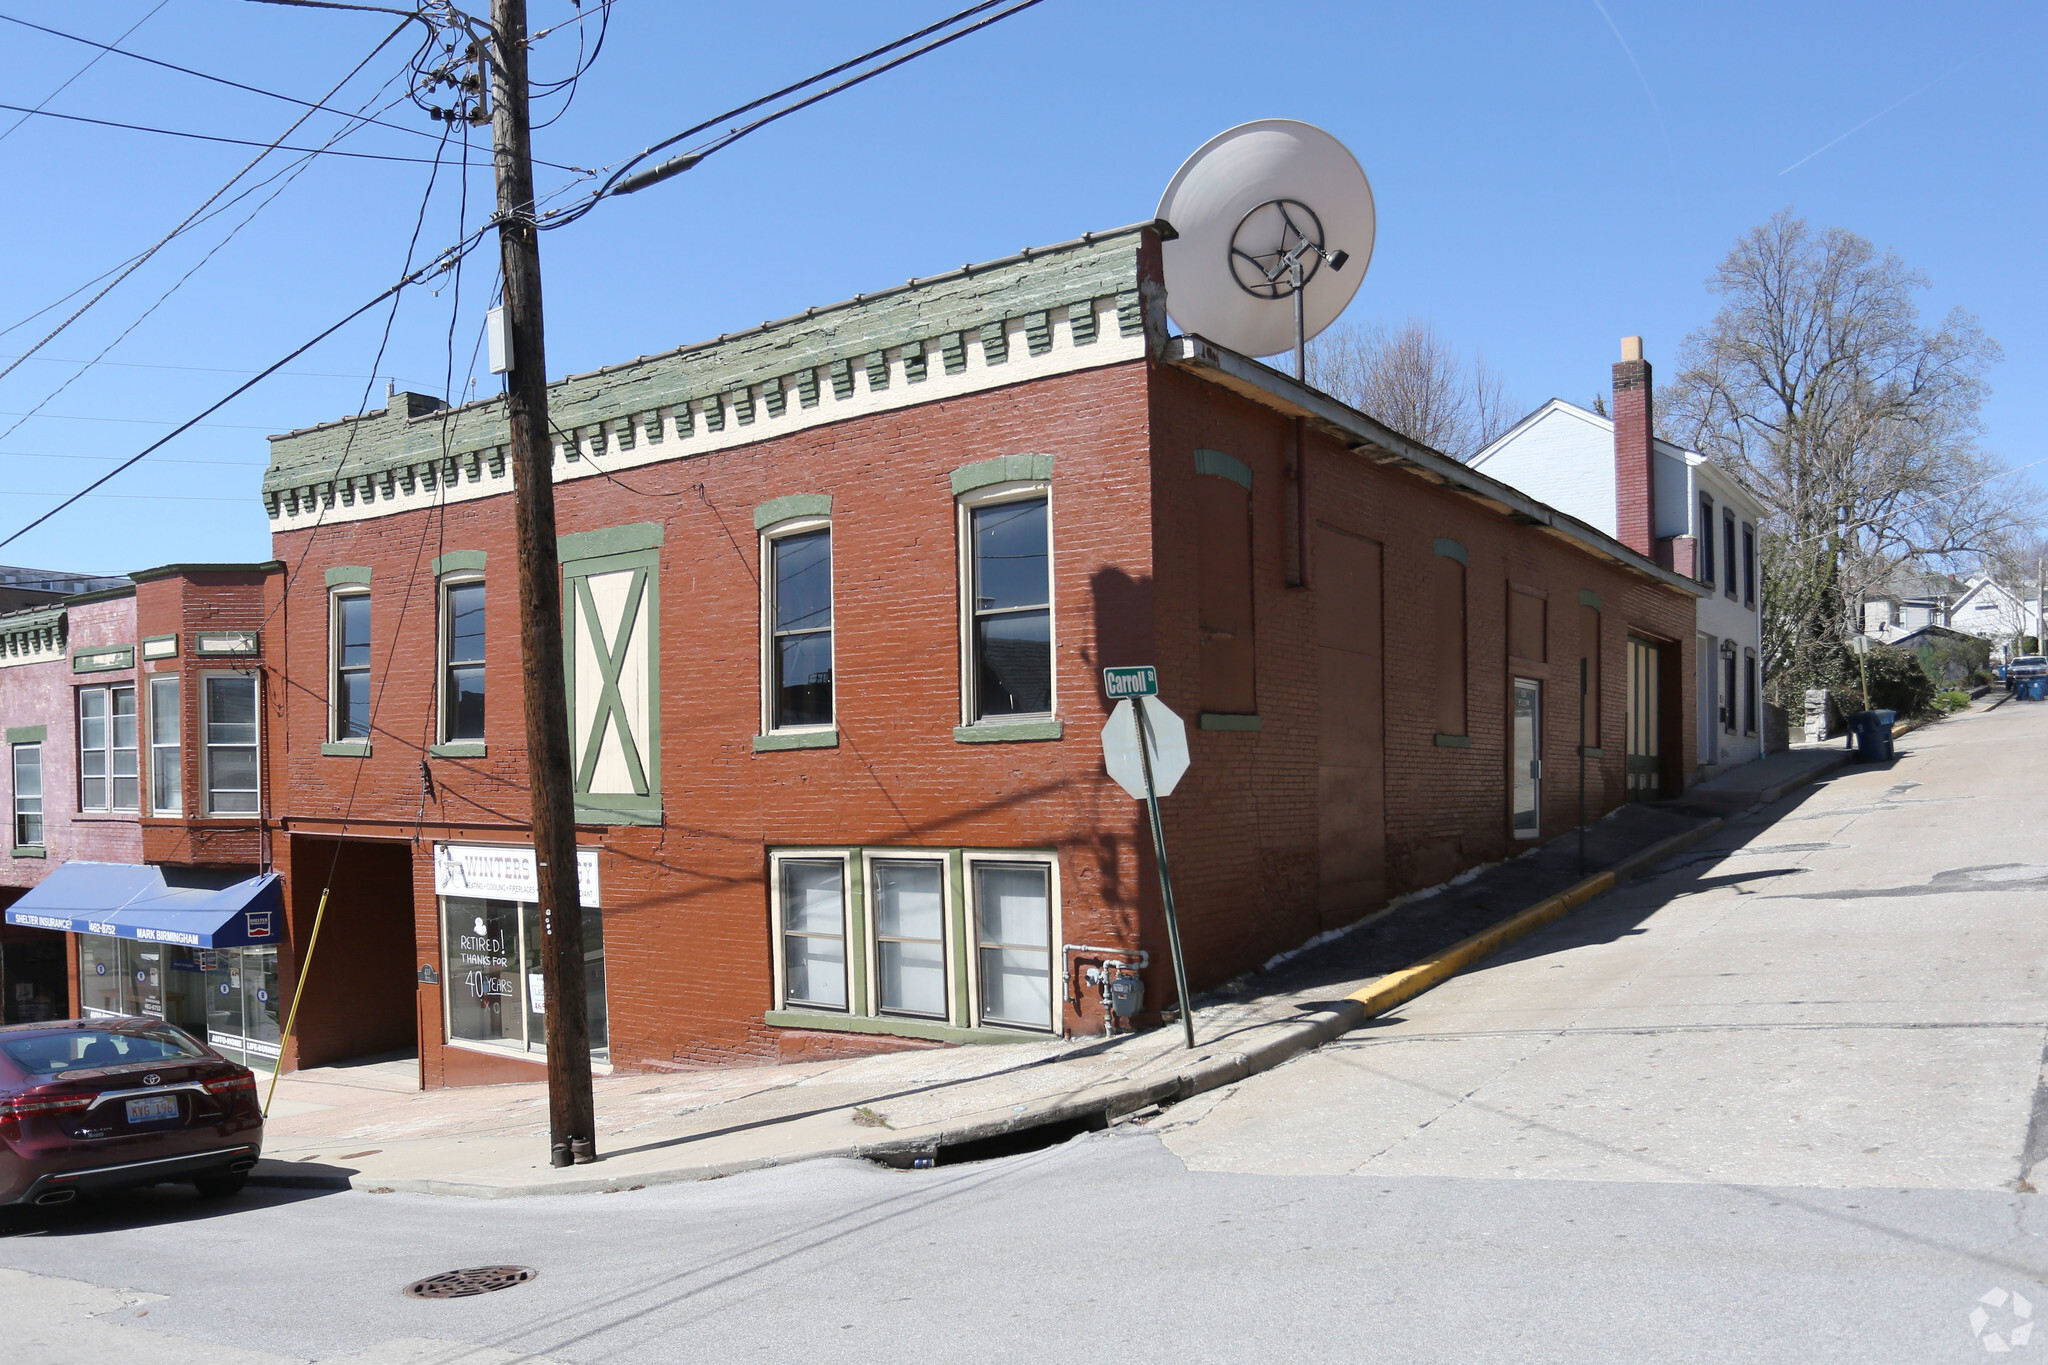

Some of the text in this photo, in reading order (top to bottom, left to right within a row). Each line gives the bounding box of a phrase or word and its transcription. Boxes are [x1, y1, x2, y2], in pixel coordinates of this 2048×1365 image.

[1107, 670, 1147, 694] Carroll
[464, 855, 530, 880] WINTERS
[486, 883, 506, 892] COOLING
[508, 885, 536, 894] FIREPLACES
[15, 914, 38, 925] SHELTER
[89, 922, 116, 935] 462-8752
[136, 928, 199, 945] MARK BIRMINGHAM
[460, 952, 508, 968] THANKS FOR
[465, 970, 514, 998] 40 YEARS
[211, 1034, 243, 1048] AUTO-HOME
[155, 1103, 174, 1115] 196
